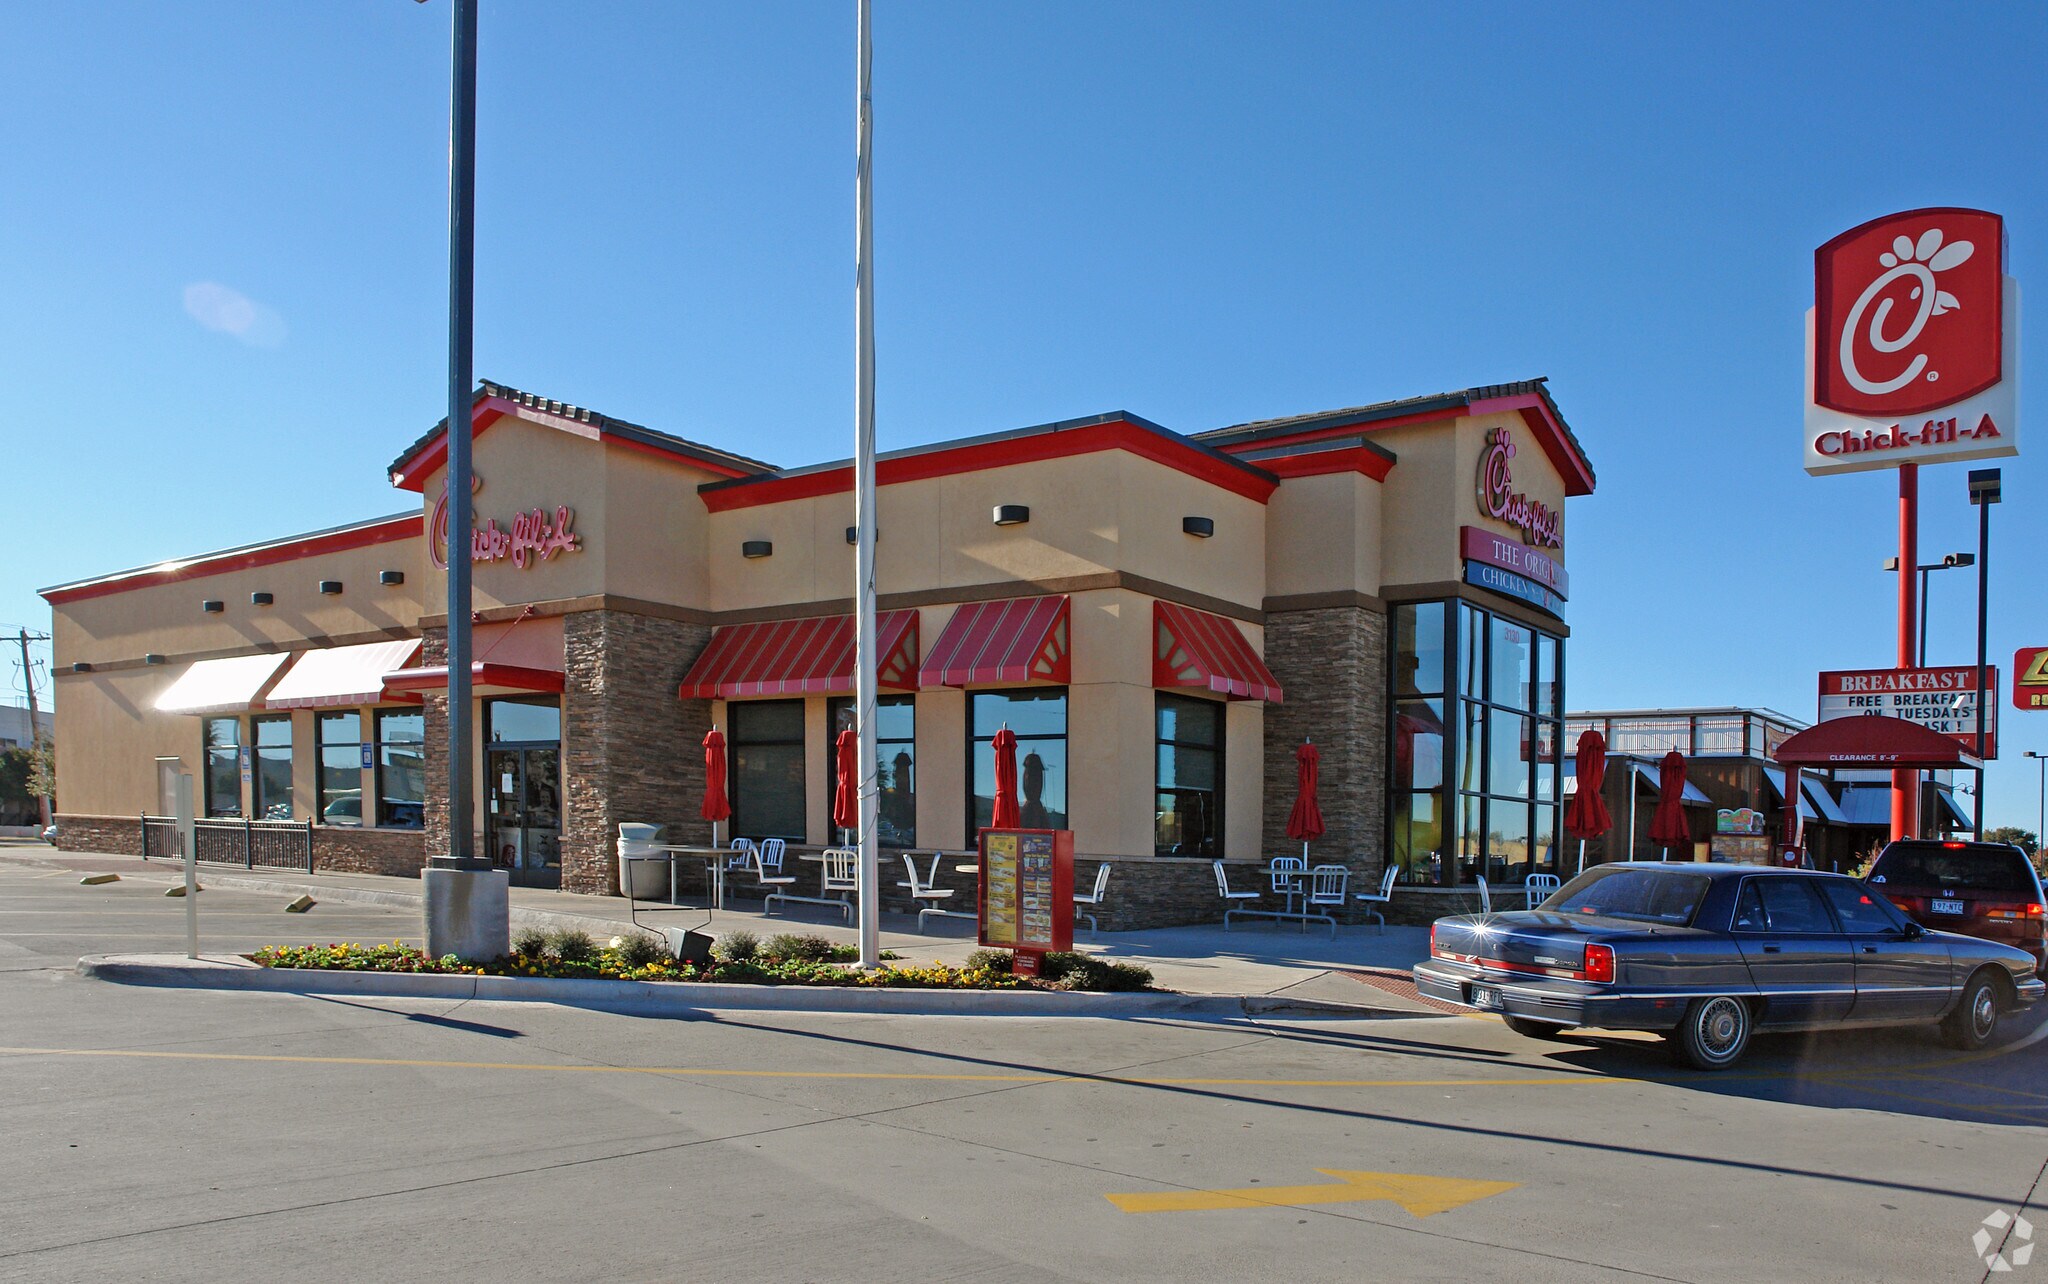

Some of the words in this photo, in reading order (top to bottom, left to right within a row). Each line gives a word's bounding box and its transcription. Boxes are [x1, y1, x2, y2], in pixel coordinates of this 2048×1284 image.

[1814, 413, 2001, 456] Chick-fil-A
[1492, 540, 1519, 566] THE
[1841, 671, 1969, 692] BREAKFAST
[1848, 695, 1882, 707] FREE
[1893, 692, 1976, 706] BREAKFAT
[1864, 709, 1882, 717] ON
[1896, 706, 1970, 719] TUESDAYS
